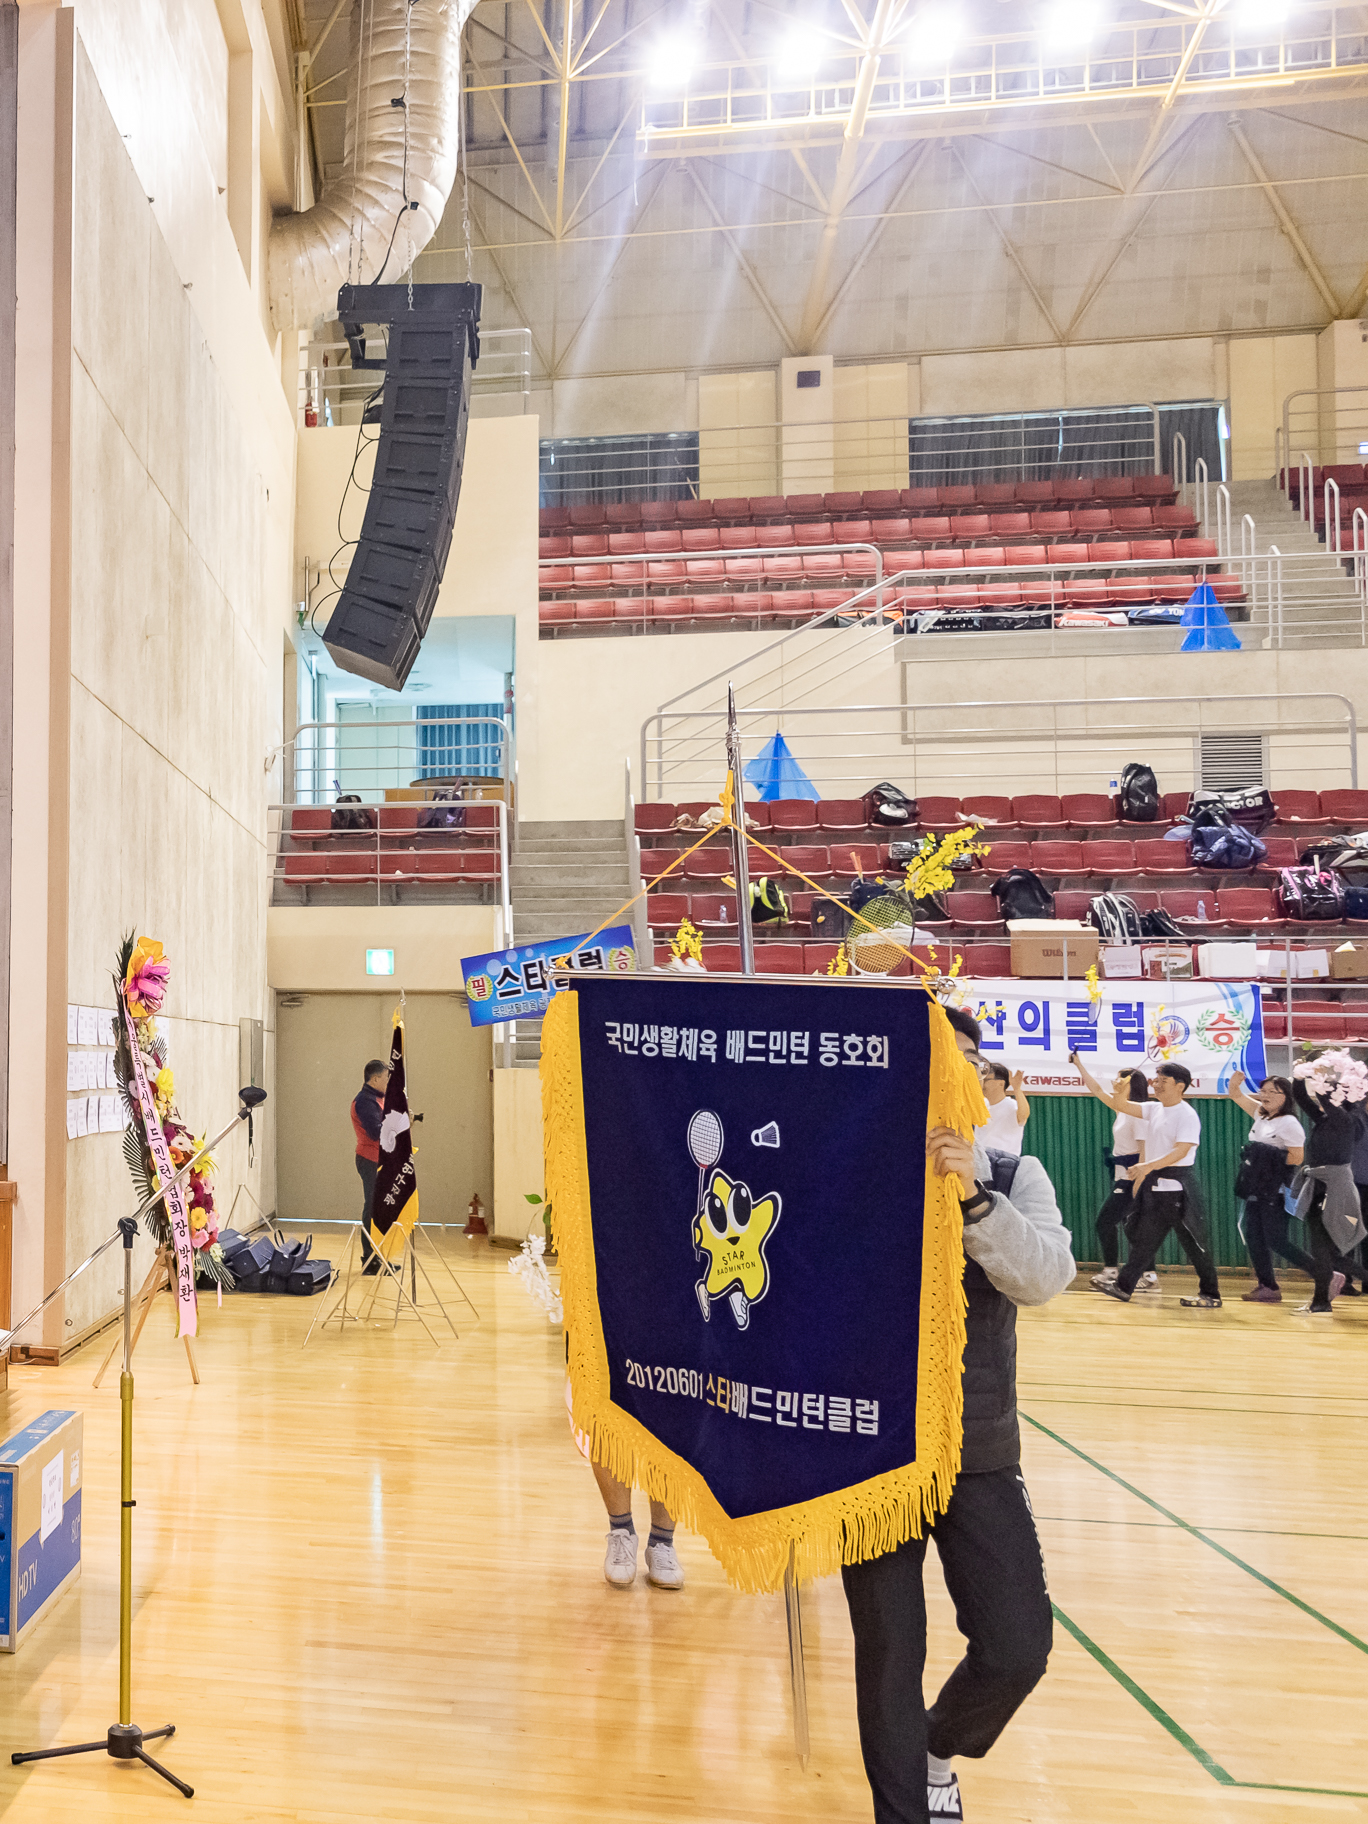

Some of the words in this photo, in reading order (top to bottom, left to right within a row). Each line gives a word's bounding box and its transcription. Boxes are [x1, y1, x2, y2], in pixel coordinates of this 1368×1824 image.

[1224, 796, 1263, 810] ICTOR
[472, 977, 487, 998] 필
[614, 950, 629, 970] 승
[1205, 1012, 1241, 1047] 승
[604, 1021, 718, 1064] 국민생활체육
[725, 1029, 810, 1065] 배드민턴
[818, 1032, 890, 1069] 동호회
[716, 1261, 756, 1276] BADMINTON
[721, 1250, 745, 1266] STAR
[927, 1783, 961, 1812] IKE
